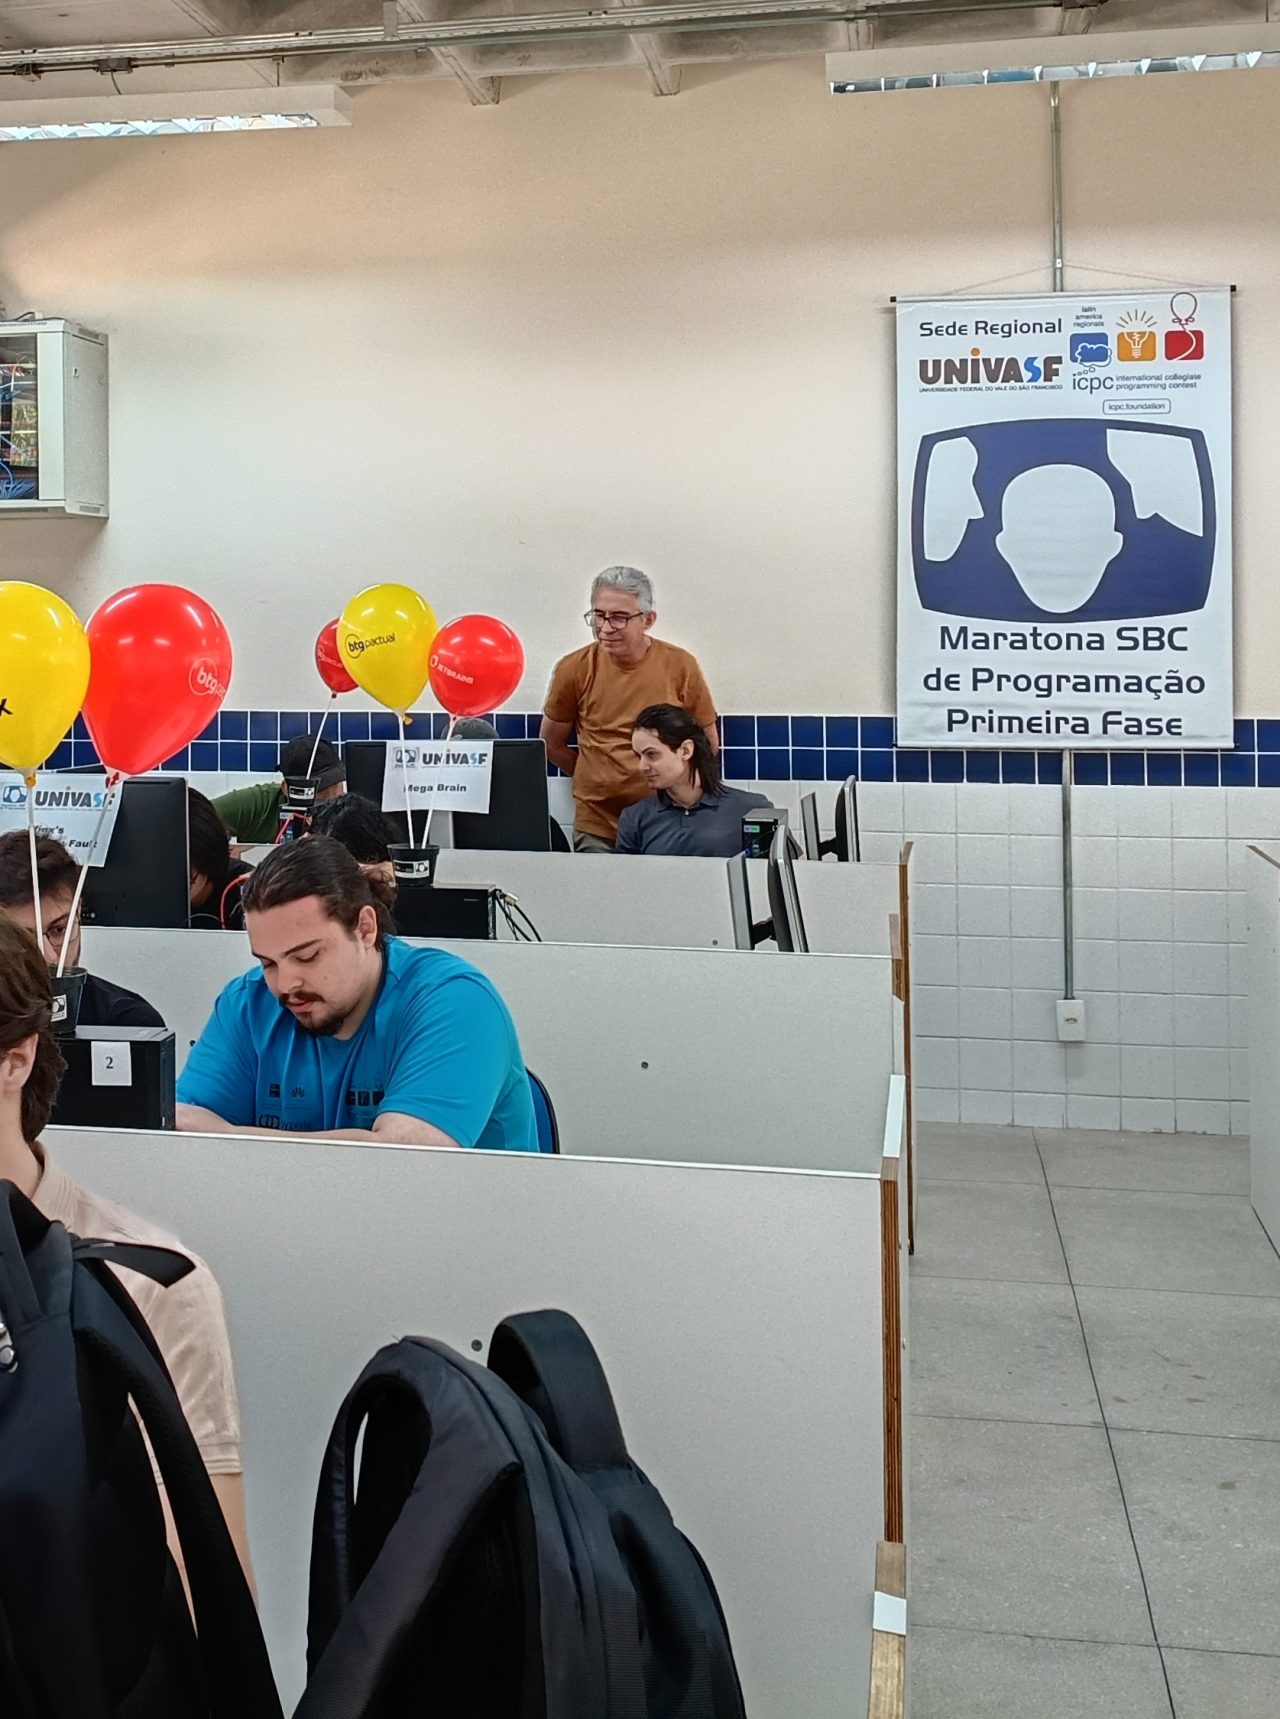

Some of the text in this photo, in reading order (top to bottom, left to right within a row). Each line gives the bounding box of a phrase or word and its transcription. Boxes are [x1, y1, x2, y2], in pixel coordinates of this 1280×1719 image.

[919, 318, 1062, 338] Sede Regional
[919, 347, 1063, 385] UNIVASF
[1072, 373, 1114, 394] icpc
[1116, 382, 1166, 390] programming
[1165, 373, 1201, 381] collegiate
[940, 626, 1188, 652] Maratona SBC
[923, 667, 1206, 700] de Programação
[946, 709, 1183, 736] Primeira Fase
[422, 748, 488, 765] UNIVASF
[437, 784, 467, 792] Brain
[105, 1056, 114, 1070] 2
